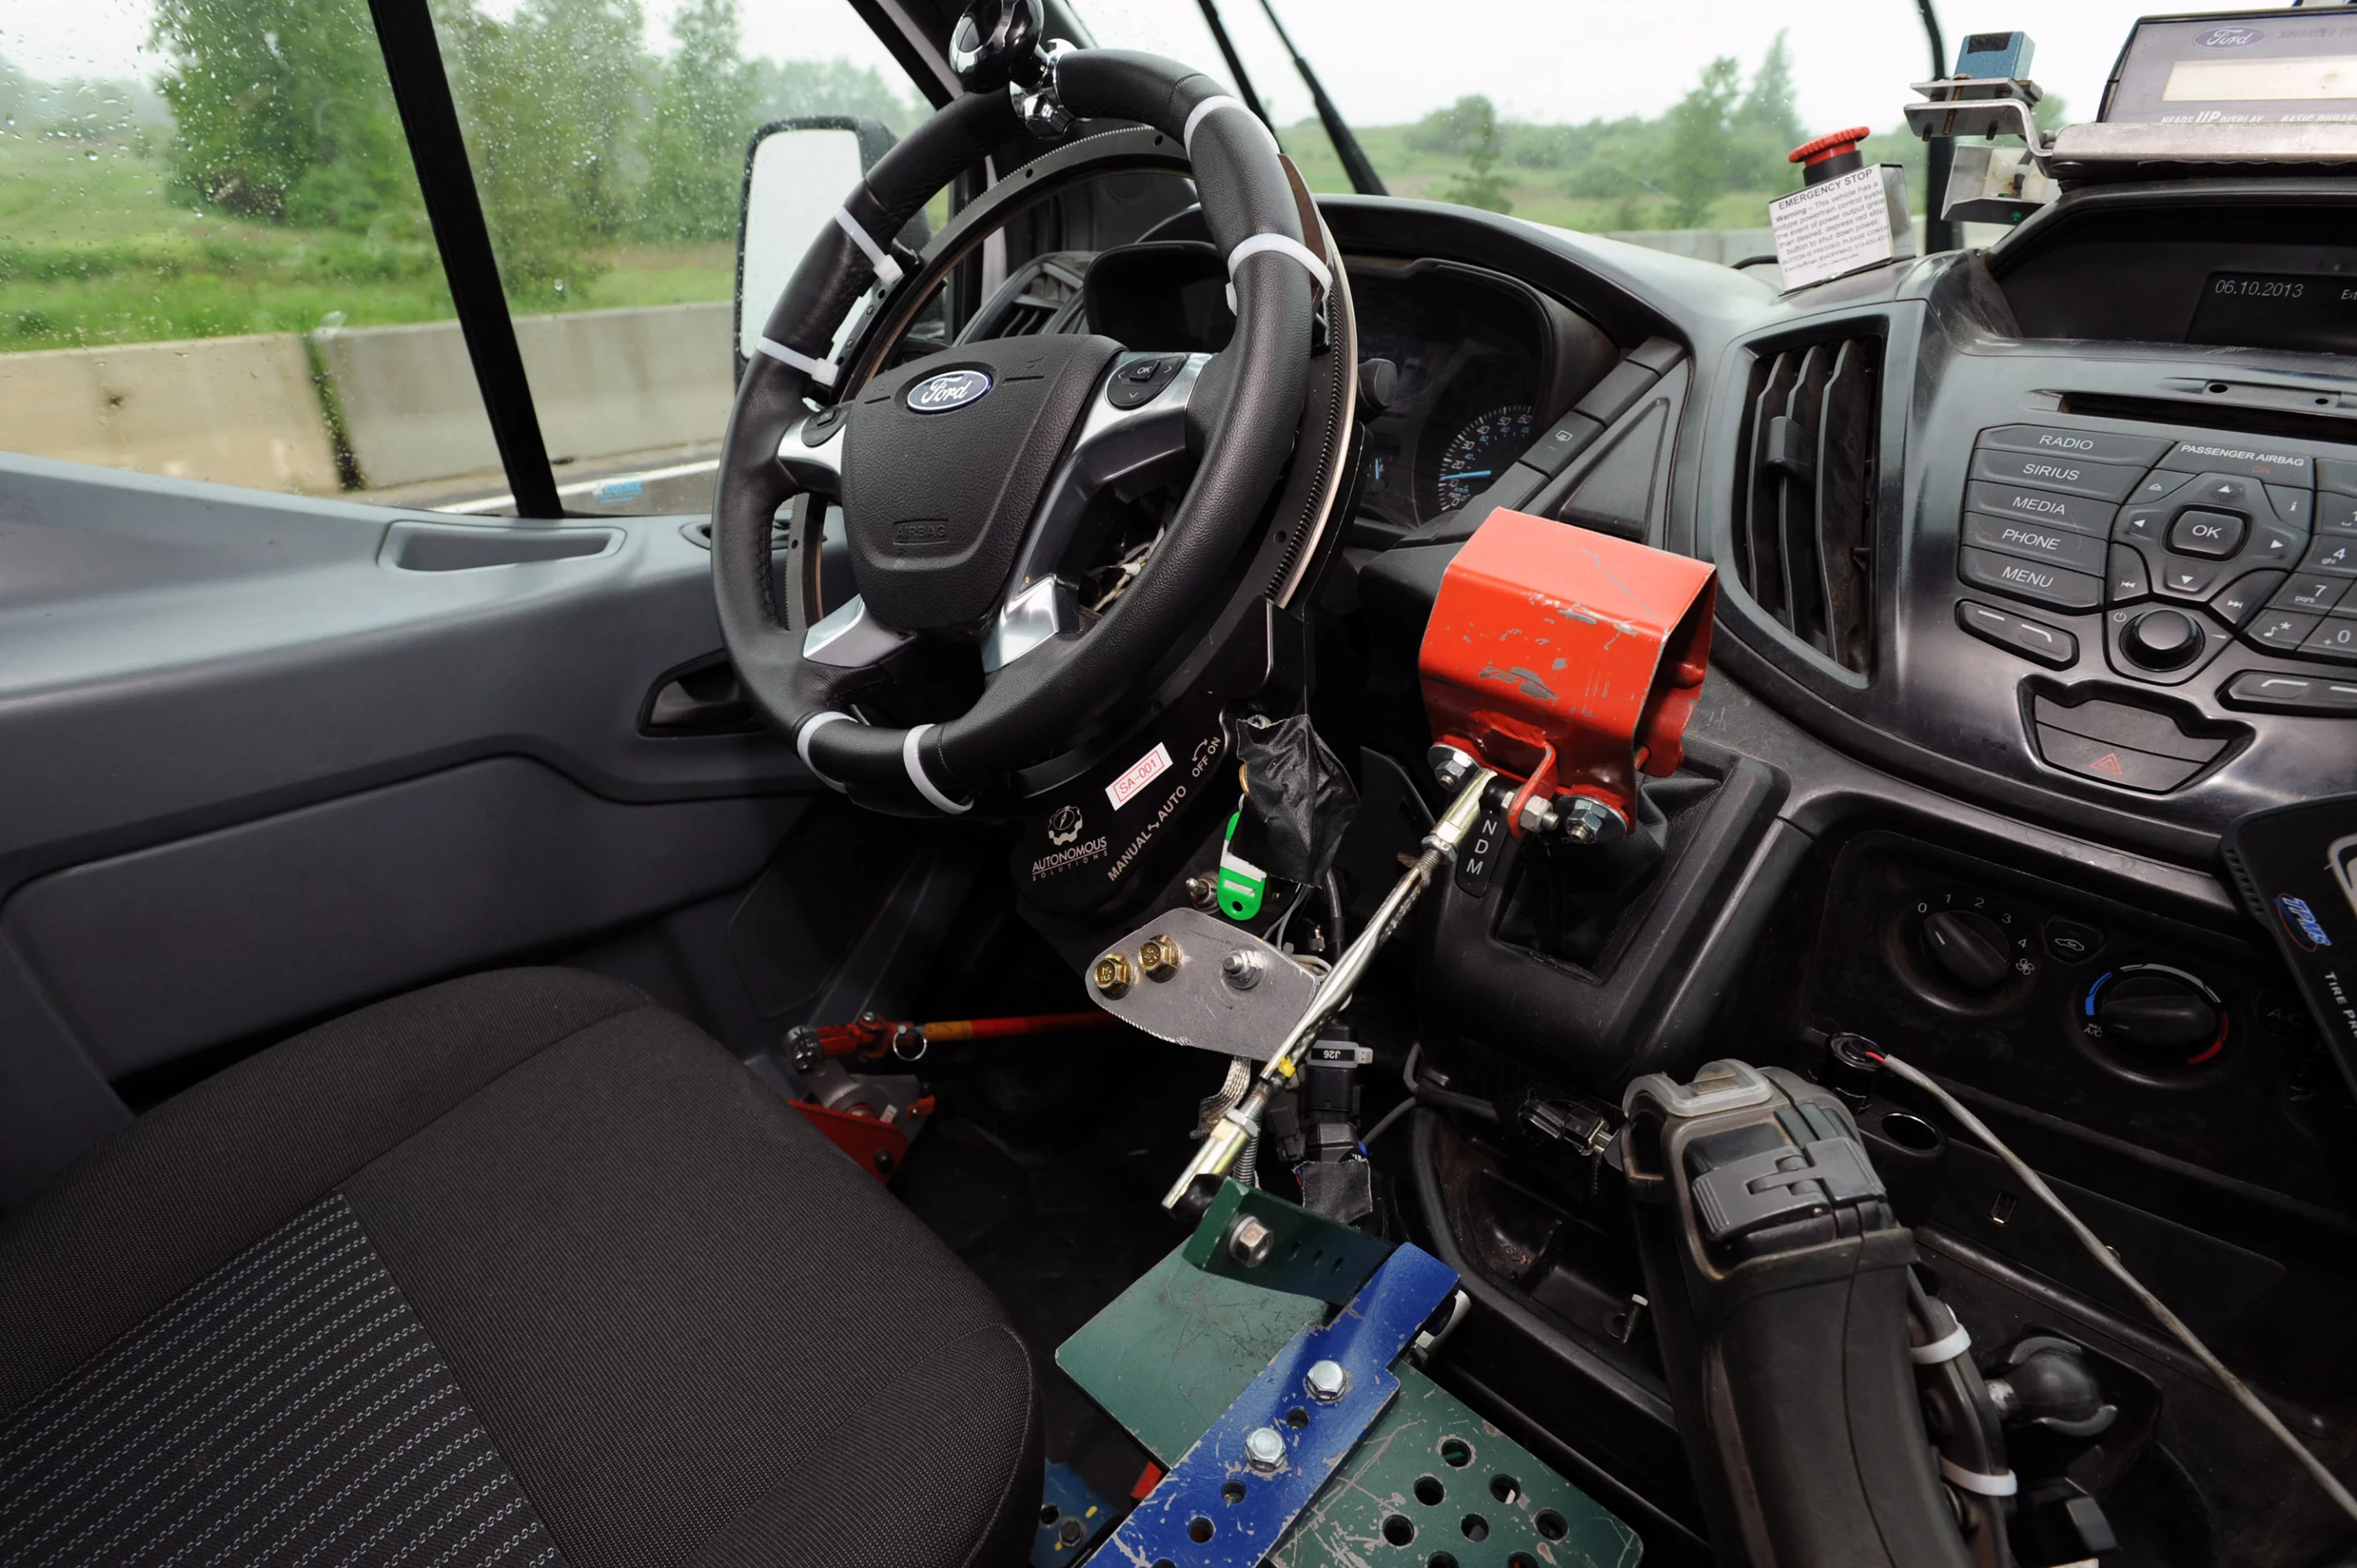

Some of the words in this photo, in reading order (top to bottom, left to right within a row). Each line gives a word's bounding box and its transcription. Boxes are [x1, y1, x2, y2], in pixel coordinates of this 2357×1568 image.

[2206, 29, 2254, 45] Ford
[2161, 116, 2194, 124] HEADS
[2195, 111, 2222, 124] UP
[2220, 115, 2265, 124] DISPLAY
[1778, 181, 1842, 210] EMERGENCY
[1845, 169, 1873, 186] STOP
[1776, 208, 1806, 223] Warning
[1815, 199, 1829, 208] This
[1832, 189, 1856, 202] vehicle
[1858, 183, 1871, 193] has
[1800, 206, 1836, 224] powertrain
[1838, 196, 1862, 209] control
[1790, 225, 1809, 236] event
[1819, 214, 1841, 226] power
[1842, 205, 1864, 218] output
[1826, 219, 1853, 232] depress
[1855, 214, 1867, 222] red
[1869, 207, 1885, 218] stop
[1787, 243, 1809, 255] button
[1818, 234, 1833, 243] shut
[1836, 228, 1854, 237] down
[1843, 233, 1865, 245] PLEASE
[2215, 279, 2304, 298] 06.10.2013
[1137, 366, 1152, 374] OK
[920, 373, 971, 403] Ford
[2039, 435, 2093, 451] RADIO
[2180, 444, 2256, 461] PASSENGER
[2255, 453, 2305, 466] AIRBAG
[2022, 463, 2080, 481] SIRIUS
[2012, 496, 2066, 516] MEDIA
[897, 525, 947, 538] AIRBAG
[2002, 529, 2061, 550] PHONE
[2192, 525, 2223, 540] OK
[2321, 557, 2337, 565] ghi
[2333, 547, 2346, 560] 4
[2002, 566, 2054, 588] MENU
[2315, 584, 2327, 597] 7
[2295, 595, 2314, 604] pqrs
[2337, 629, 2350, 644] 0
[1191, 755, 1210, 777] OFF
[1206, 737, 1221, 755] ON
[1119, 759, 1157, 795] SA-001
[1106, 831, 1152, 881] MANUAL
[1157, 786, 1187, 822] AUTO
[1481, 819, 1498, 836] N
[1032, 836, 1107, 873] AUTONOMOUS
[1474, 838, 1489, 854] D
[1032, 851, 1108, 881] SOLUTIONS
[1466, 858, 1484, 876] M
[1945, 894, 1952, 903] 1
[1974, 897, 1985, 908] 2
[1918, 903, 1927, 913] 0
[2001, 912, 2012, 924] 3
[2281, 897, 2332, 946] TPMS
[2017, 938, 2027, 948] 4
[2325, 971, 2347, 1006] TIRE
[2083, 1026, 2103, 1039] A/C
[1323, 1050, 1341, 1060] J26
